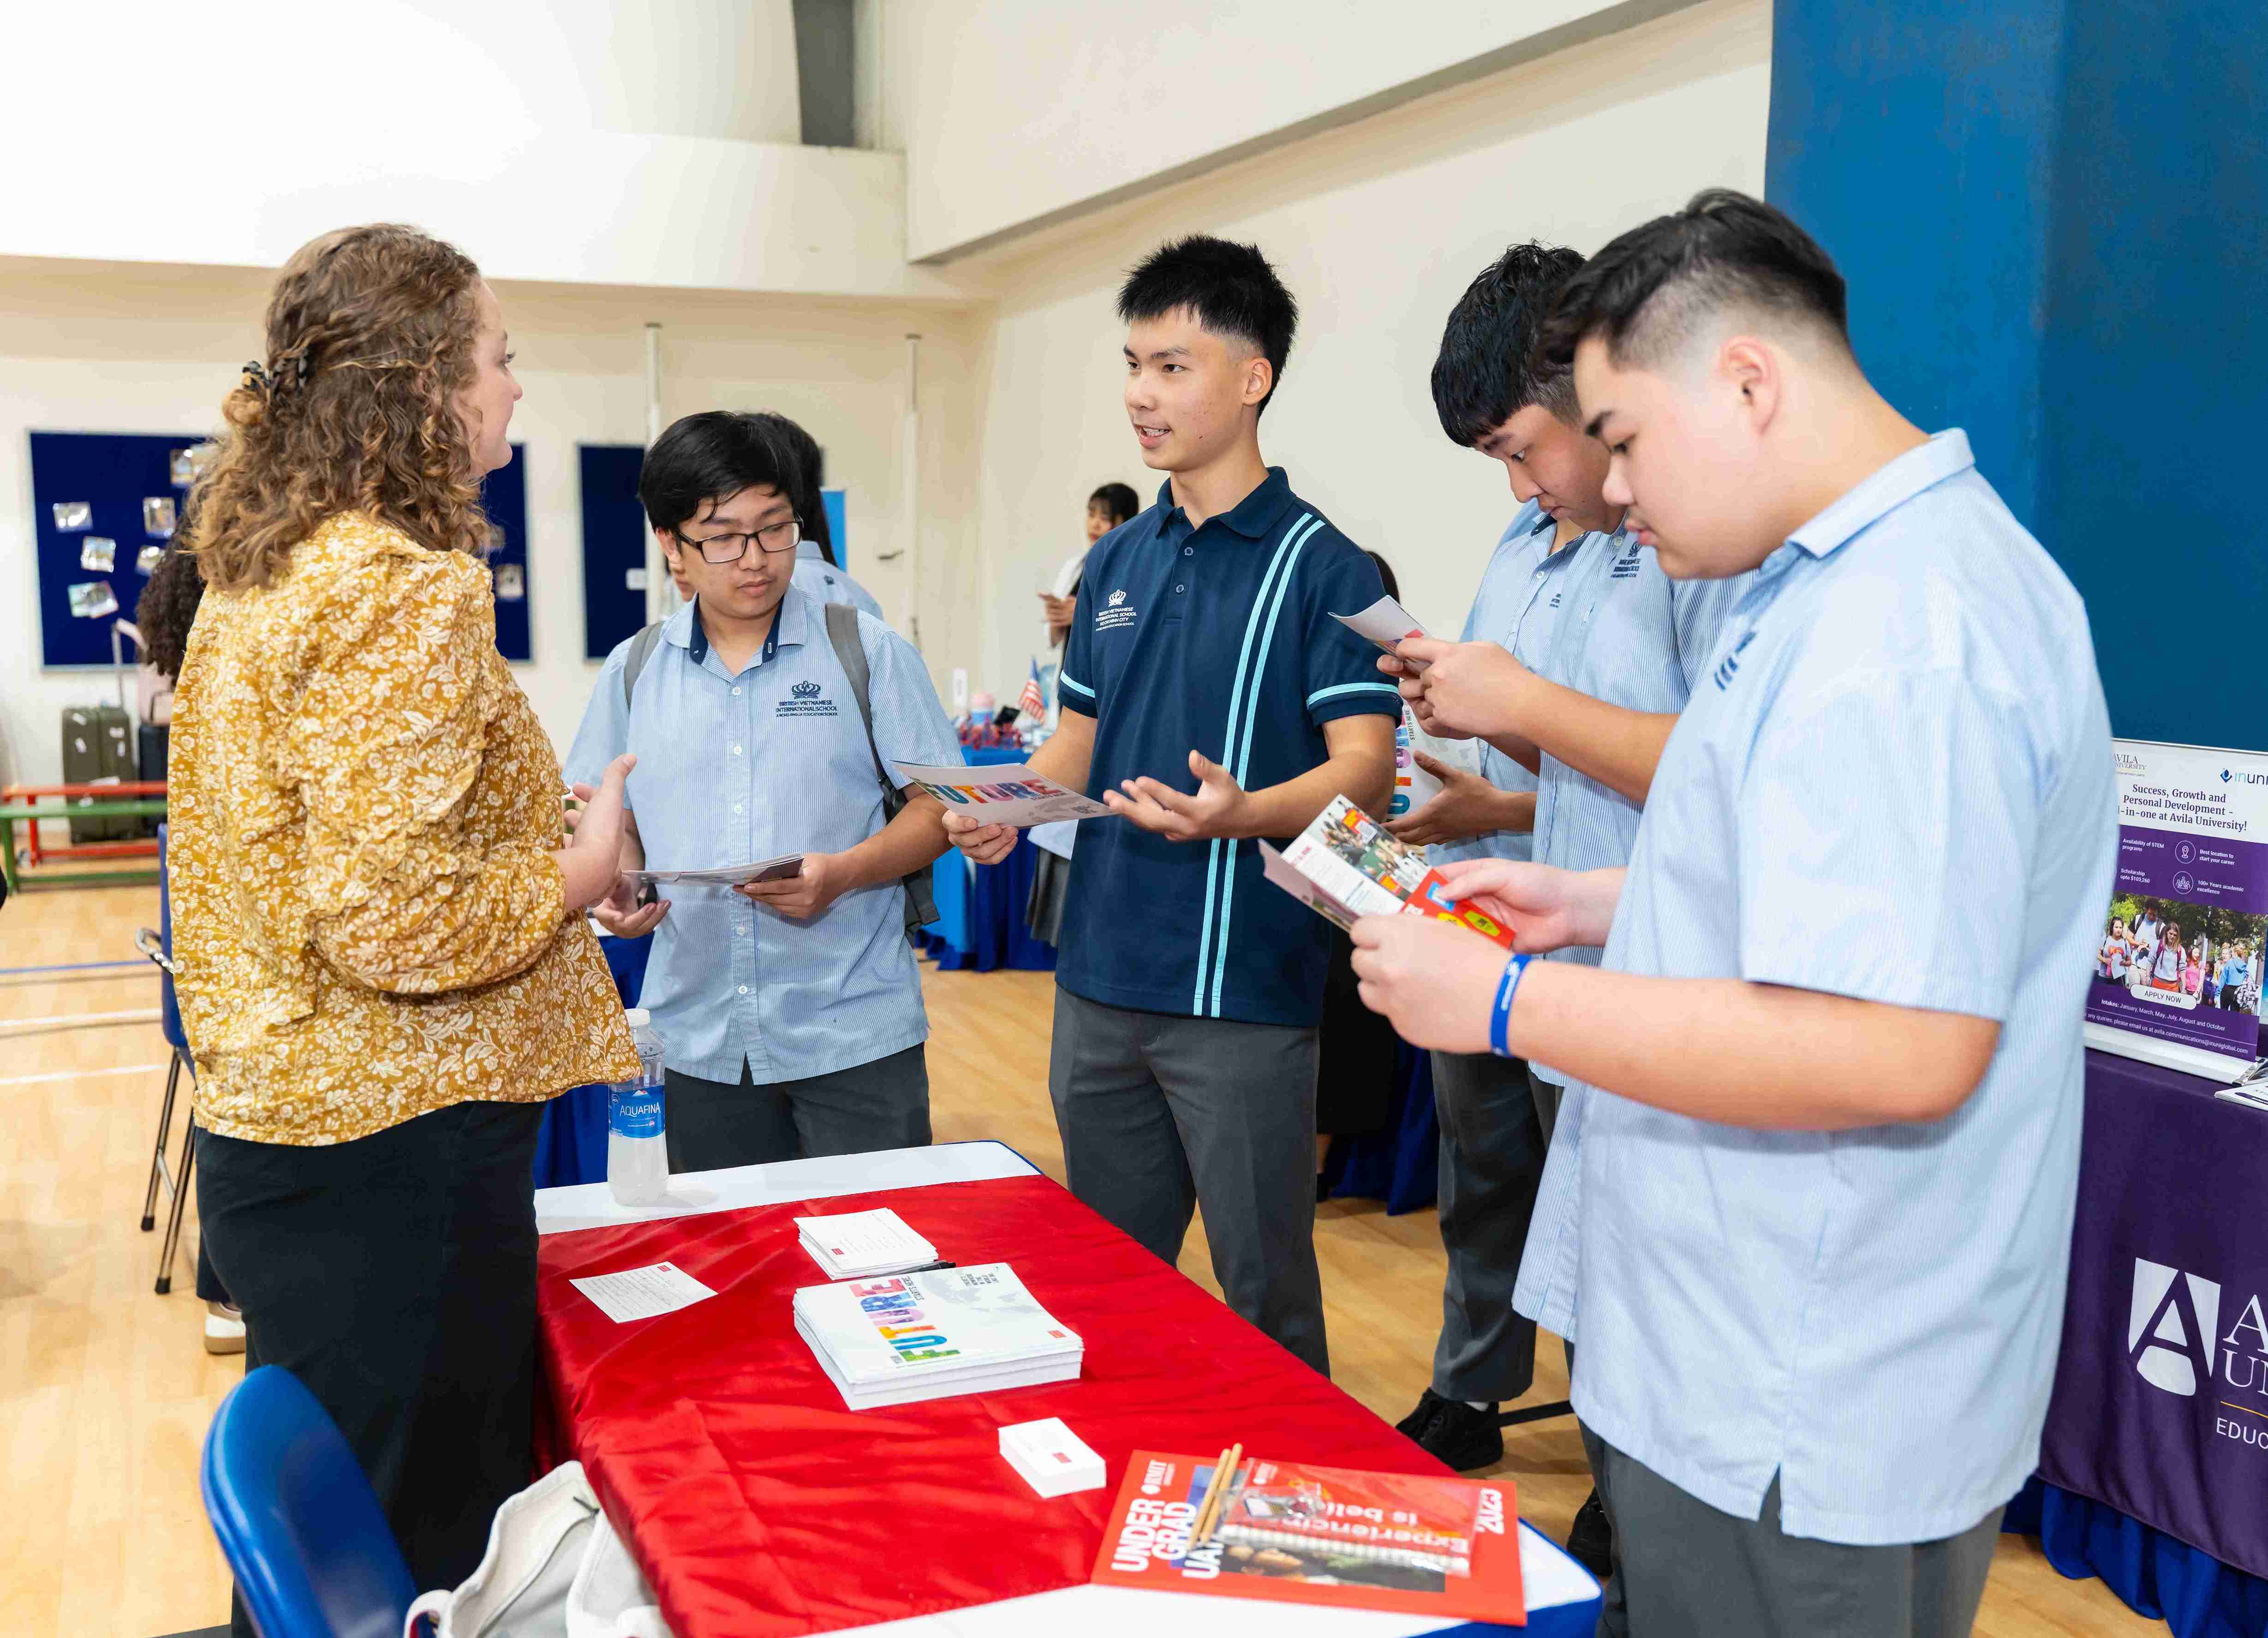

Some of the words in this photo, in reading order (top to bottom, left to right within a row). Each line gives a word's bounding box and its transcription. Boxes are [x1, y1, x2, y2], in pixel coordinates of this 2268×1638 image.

[2115, 762, 2145, 770] NIVERSITY
[910, 778, 1062, 804] FUTURE
[2132, 784, 2169, 798] Success,
[2172, 789, 2206, 801] Growth
[2208, 794, 2226, 803] and
[2123, 795, 2162, 808] Personal
[2165, 800, 2226, 816] Development
[2118, 805, 2156, 819] l-in-one
[2159, 811, 2167, 820] at
[2170, 813, 2193, 825] Avila
[2195, 816, 2248, 833] University!
[2123, 837, 2146, 847] Availability
[2210, 850, 2228, 858] location
[2121, 868, 2145, 877] Scholarship
[2222, 884, 2244, 892] academic
[2144, 990, 2164, 1000] APPLY
[2166, 993, 2182, 1004] NOW
[2096, 1015, 2113, 1023] queries,
[2114, 1017, 2128, 1027] please
[2129, 1022, 2142, 1030] email
[2101, 999, 2119, 1008] Intakes:
[2119, 1003, 2138, 1013] January,
[2139, 1007, 2154, 1016] March,
[2178, 1016, 2196, 1026] August
[2206, 1022, 2226, 1032] October
[620, 1101, 661, 1117] AQUAFINA
[849, 1279, 961, 1363] FUTURE
[1392, 1511, 1418, 1525] is
[1110, 1498, 1166, 1572] UNDER
[1151, 1501, 1198, 1560] GRAD
